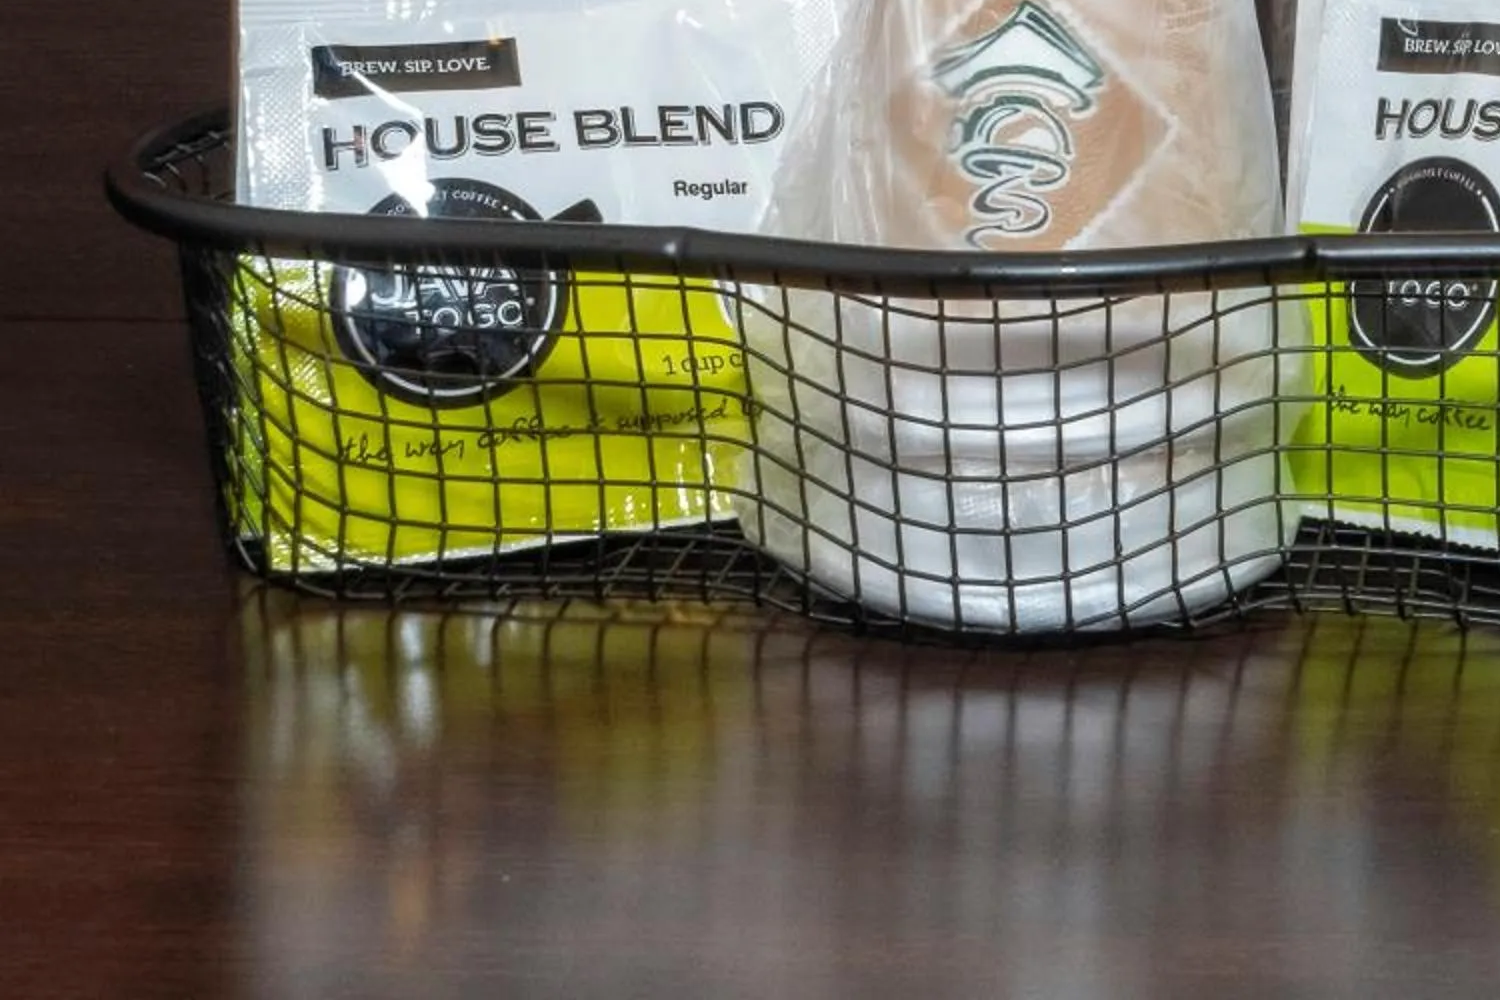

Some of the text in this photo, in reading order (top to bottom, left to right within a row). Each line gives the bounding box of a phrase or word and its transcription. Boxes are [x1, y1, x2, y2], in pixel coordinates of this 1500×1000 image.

[341, 57, 491, 77] BREW. SIP. LOVE.
[322, 101, 786, 171] HOUSE BLEND
[673, 180, 748, 202] Regular
